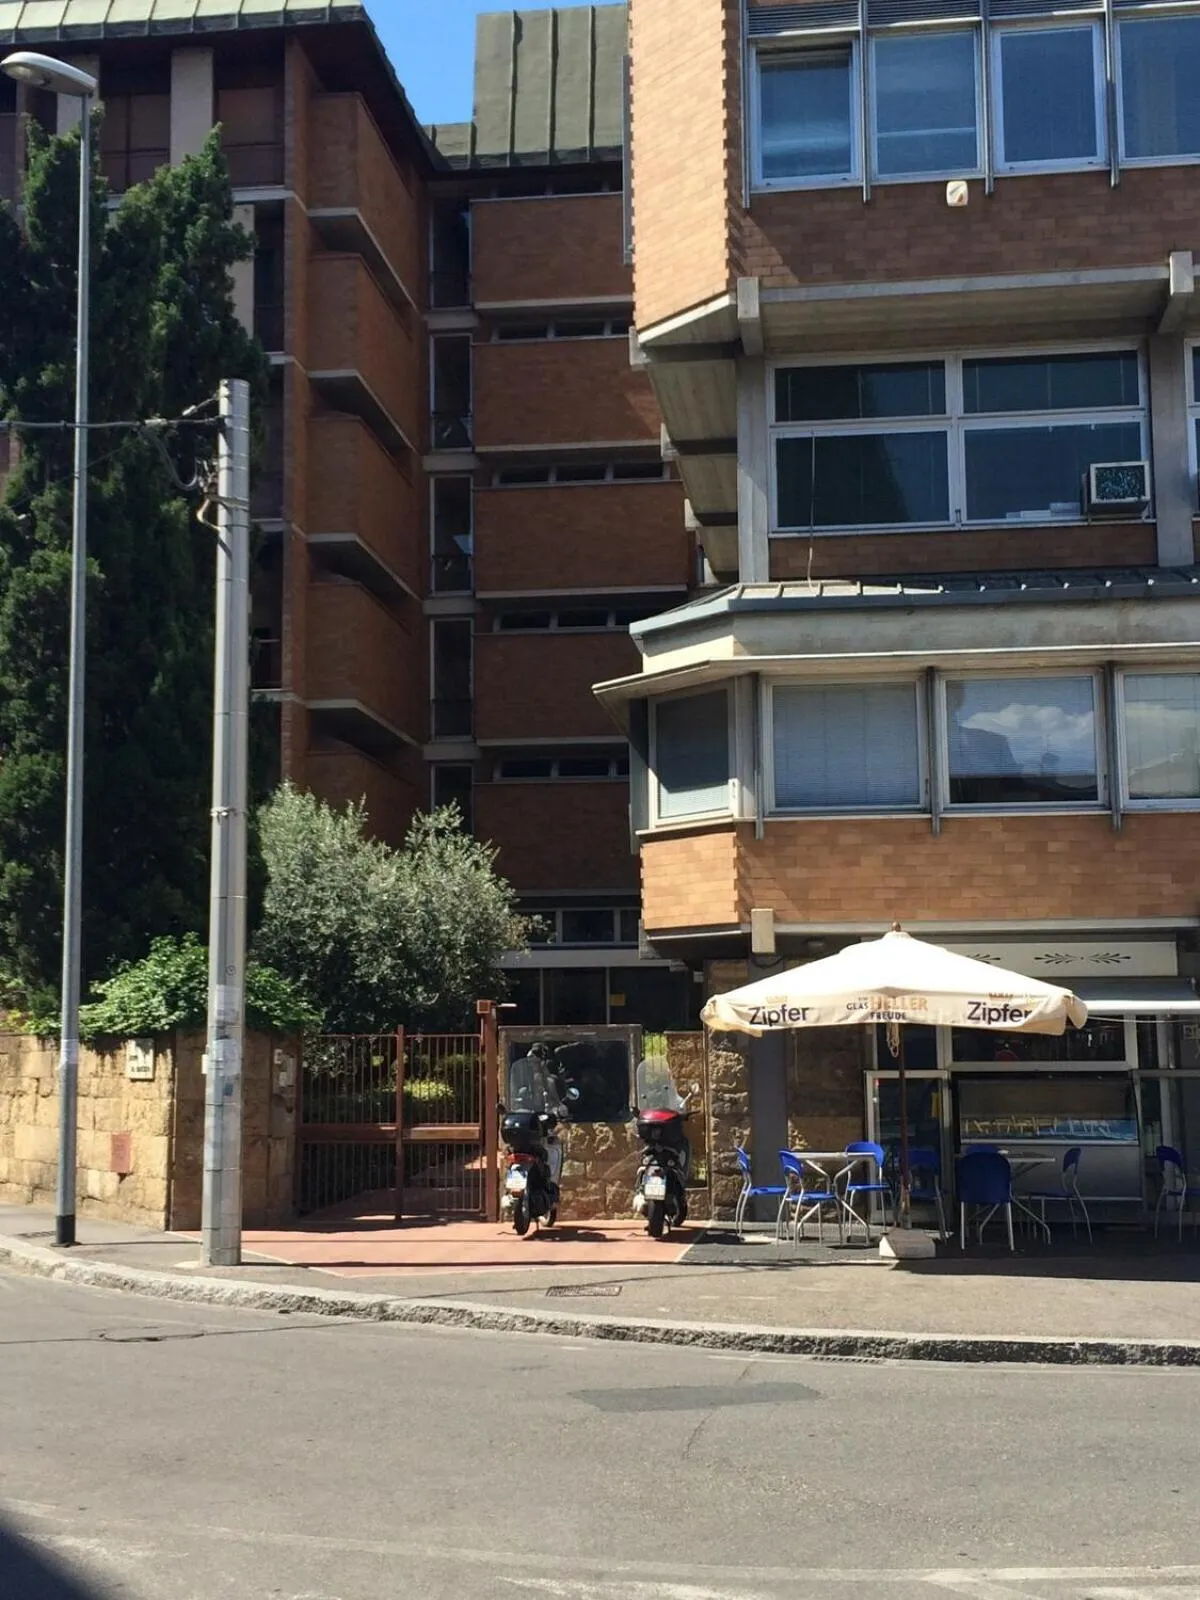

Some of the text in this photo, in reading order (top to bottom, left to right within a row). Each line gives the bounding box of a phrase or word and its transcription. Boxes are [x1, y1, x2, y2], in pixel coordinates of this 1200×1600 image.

[748, 1003, 811, 1027] Zipfer
[846, 1002, 869, 1011] GLAS
[967, 1001, 1032, 1026] Zipfer
